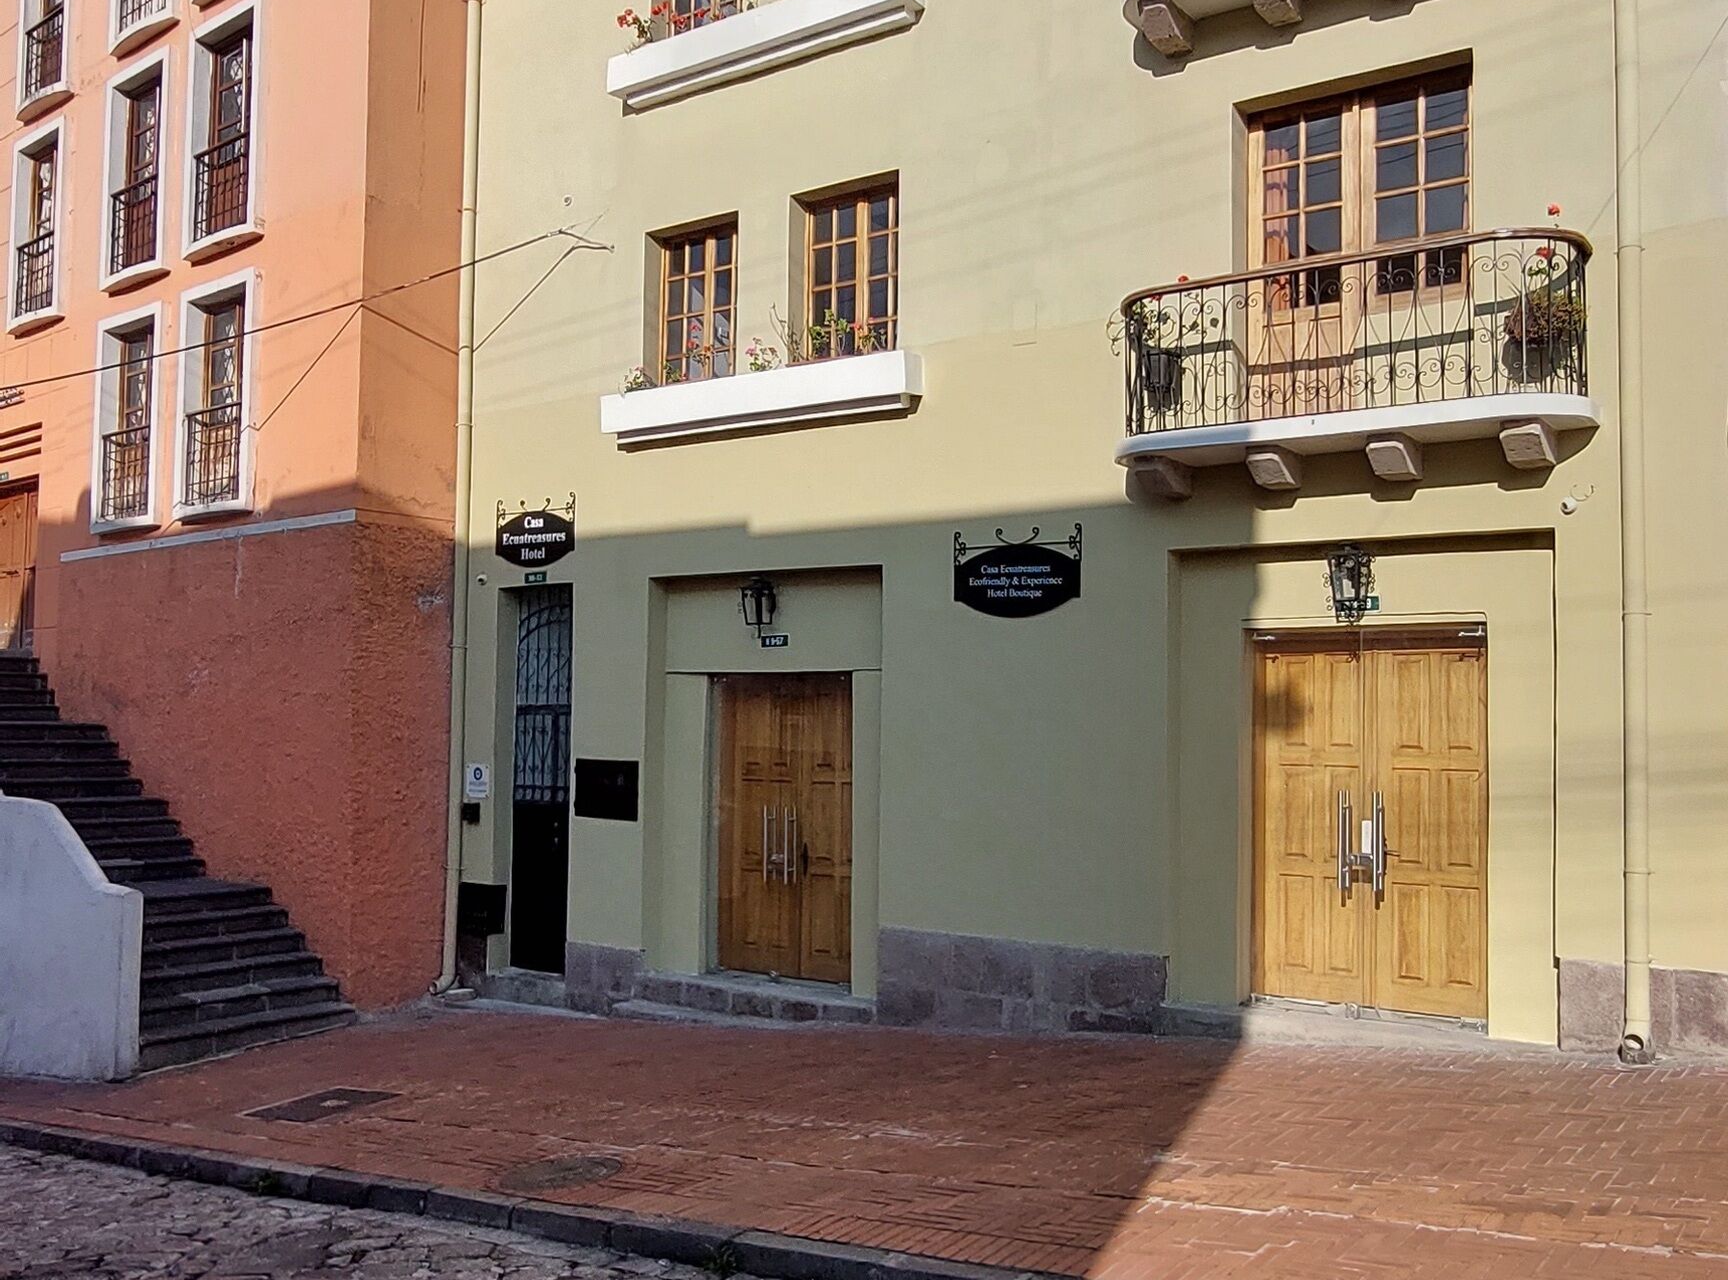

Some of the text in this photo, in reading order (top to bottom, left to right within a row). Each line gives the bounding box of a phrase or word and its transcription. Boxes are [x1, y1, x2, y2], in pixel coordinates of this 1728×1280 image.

[524, 516, 544, 528] Casa
[502, 532, 566, 546] Ecuatreasures
[521, 547, 545, 560] Hotel
[981, 565, 999, 574] Casa
[969, 576, 1063, 587] Ecofriendly & Experience
[987, 589, 1043, 599] Hotel Boutique
